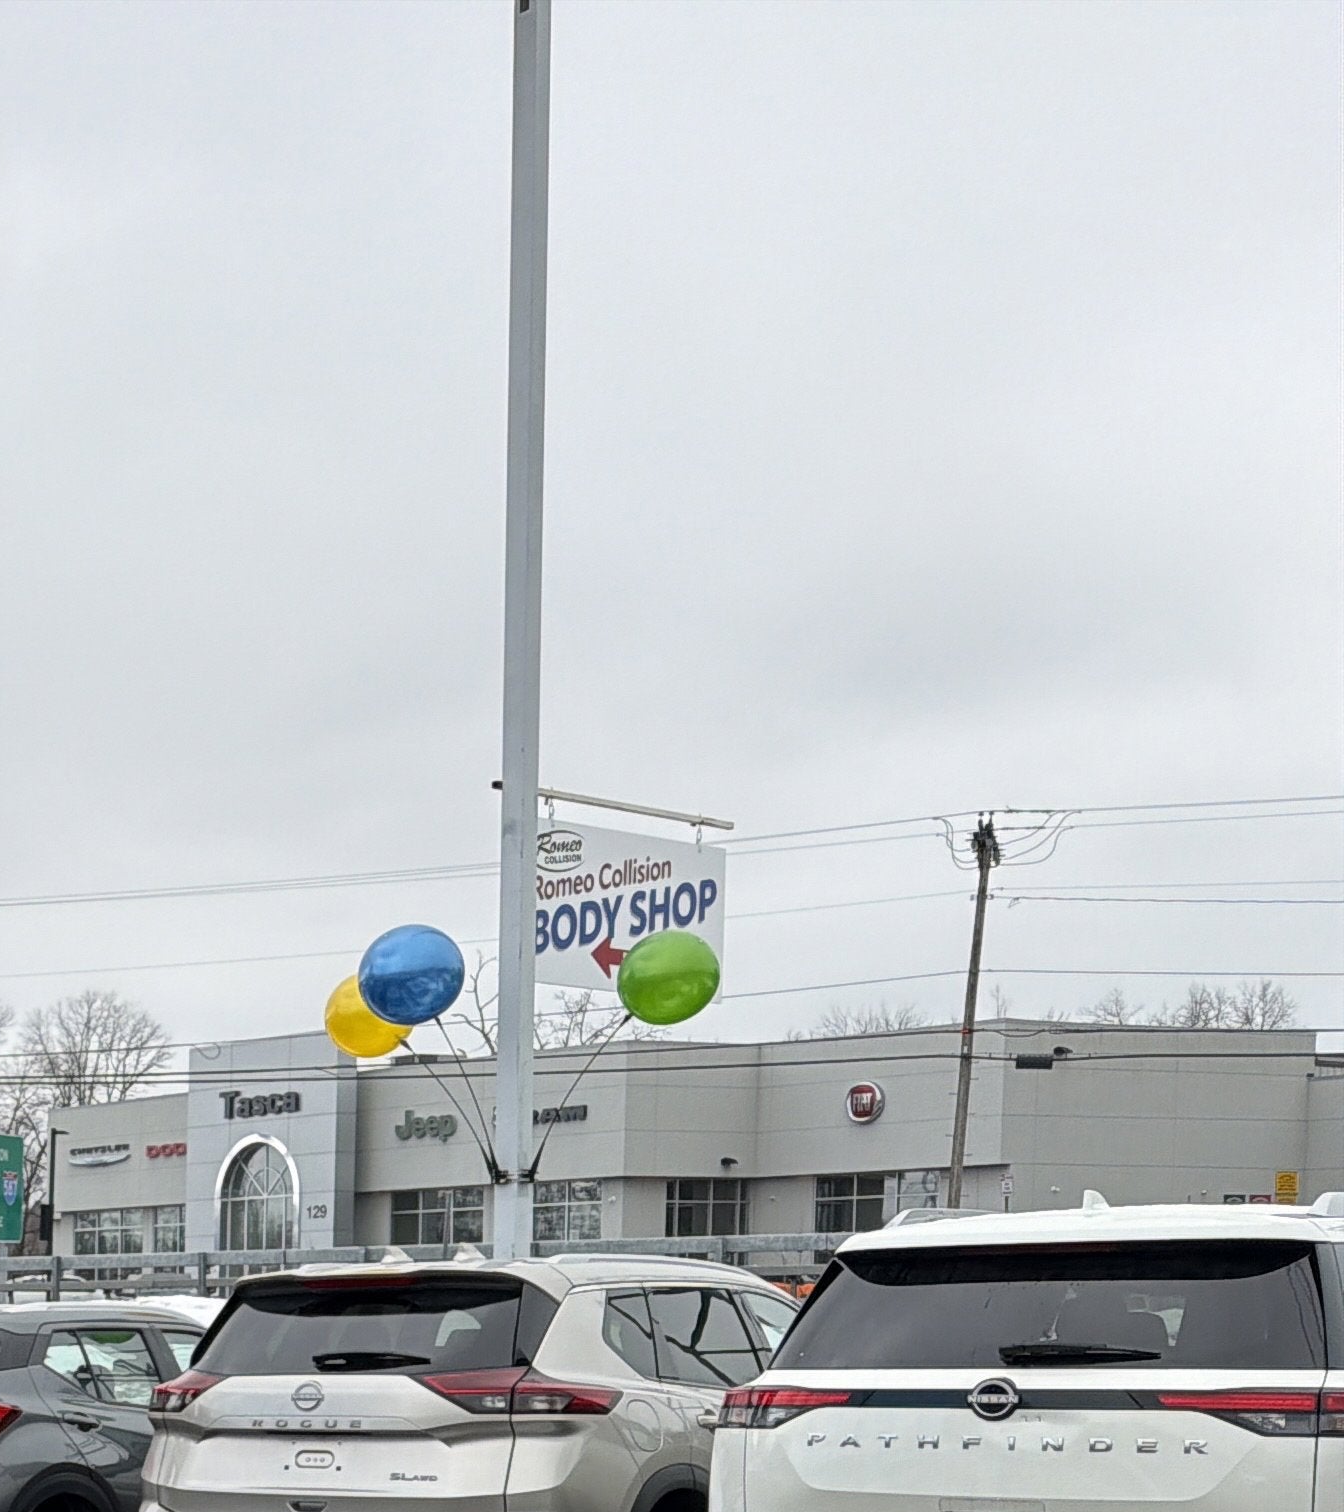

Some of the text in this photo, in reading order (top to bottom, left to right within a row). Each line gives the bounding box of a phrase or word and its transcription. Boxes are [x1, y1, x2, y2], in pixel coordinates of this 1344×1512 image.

[537, 834, 582, 855] Romeo
[544, 853, 582, 865] COLLISION
[536, 856, 672, 900] Romeo Collision
[535, 878, 717, 955] BODY SHOP
[219, 1090, 301, 1120] Tasca
[853, 1092, 873, 1112] FIAT
[395, 1110, 457, 1144] Jeep
[306, 1204, 328, 1219] 129
[252, 1418, 362, 1429] ROGUE
[806, 1431, 1209, 1456] PATHFINDER
